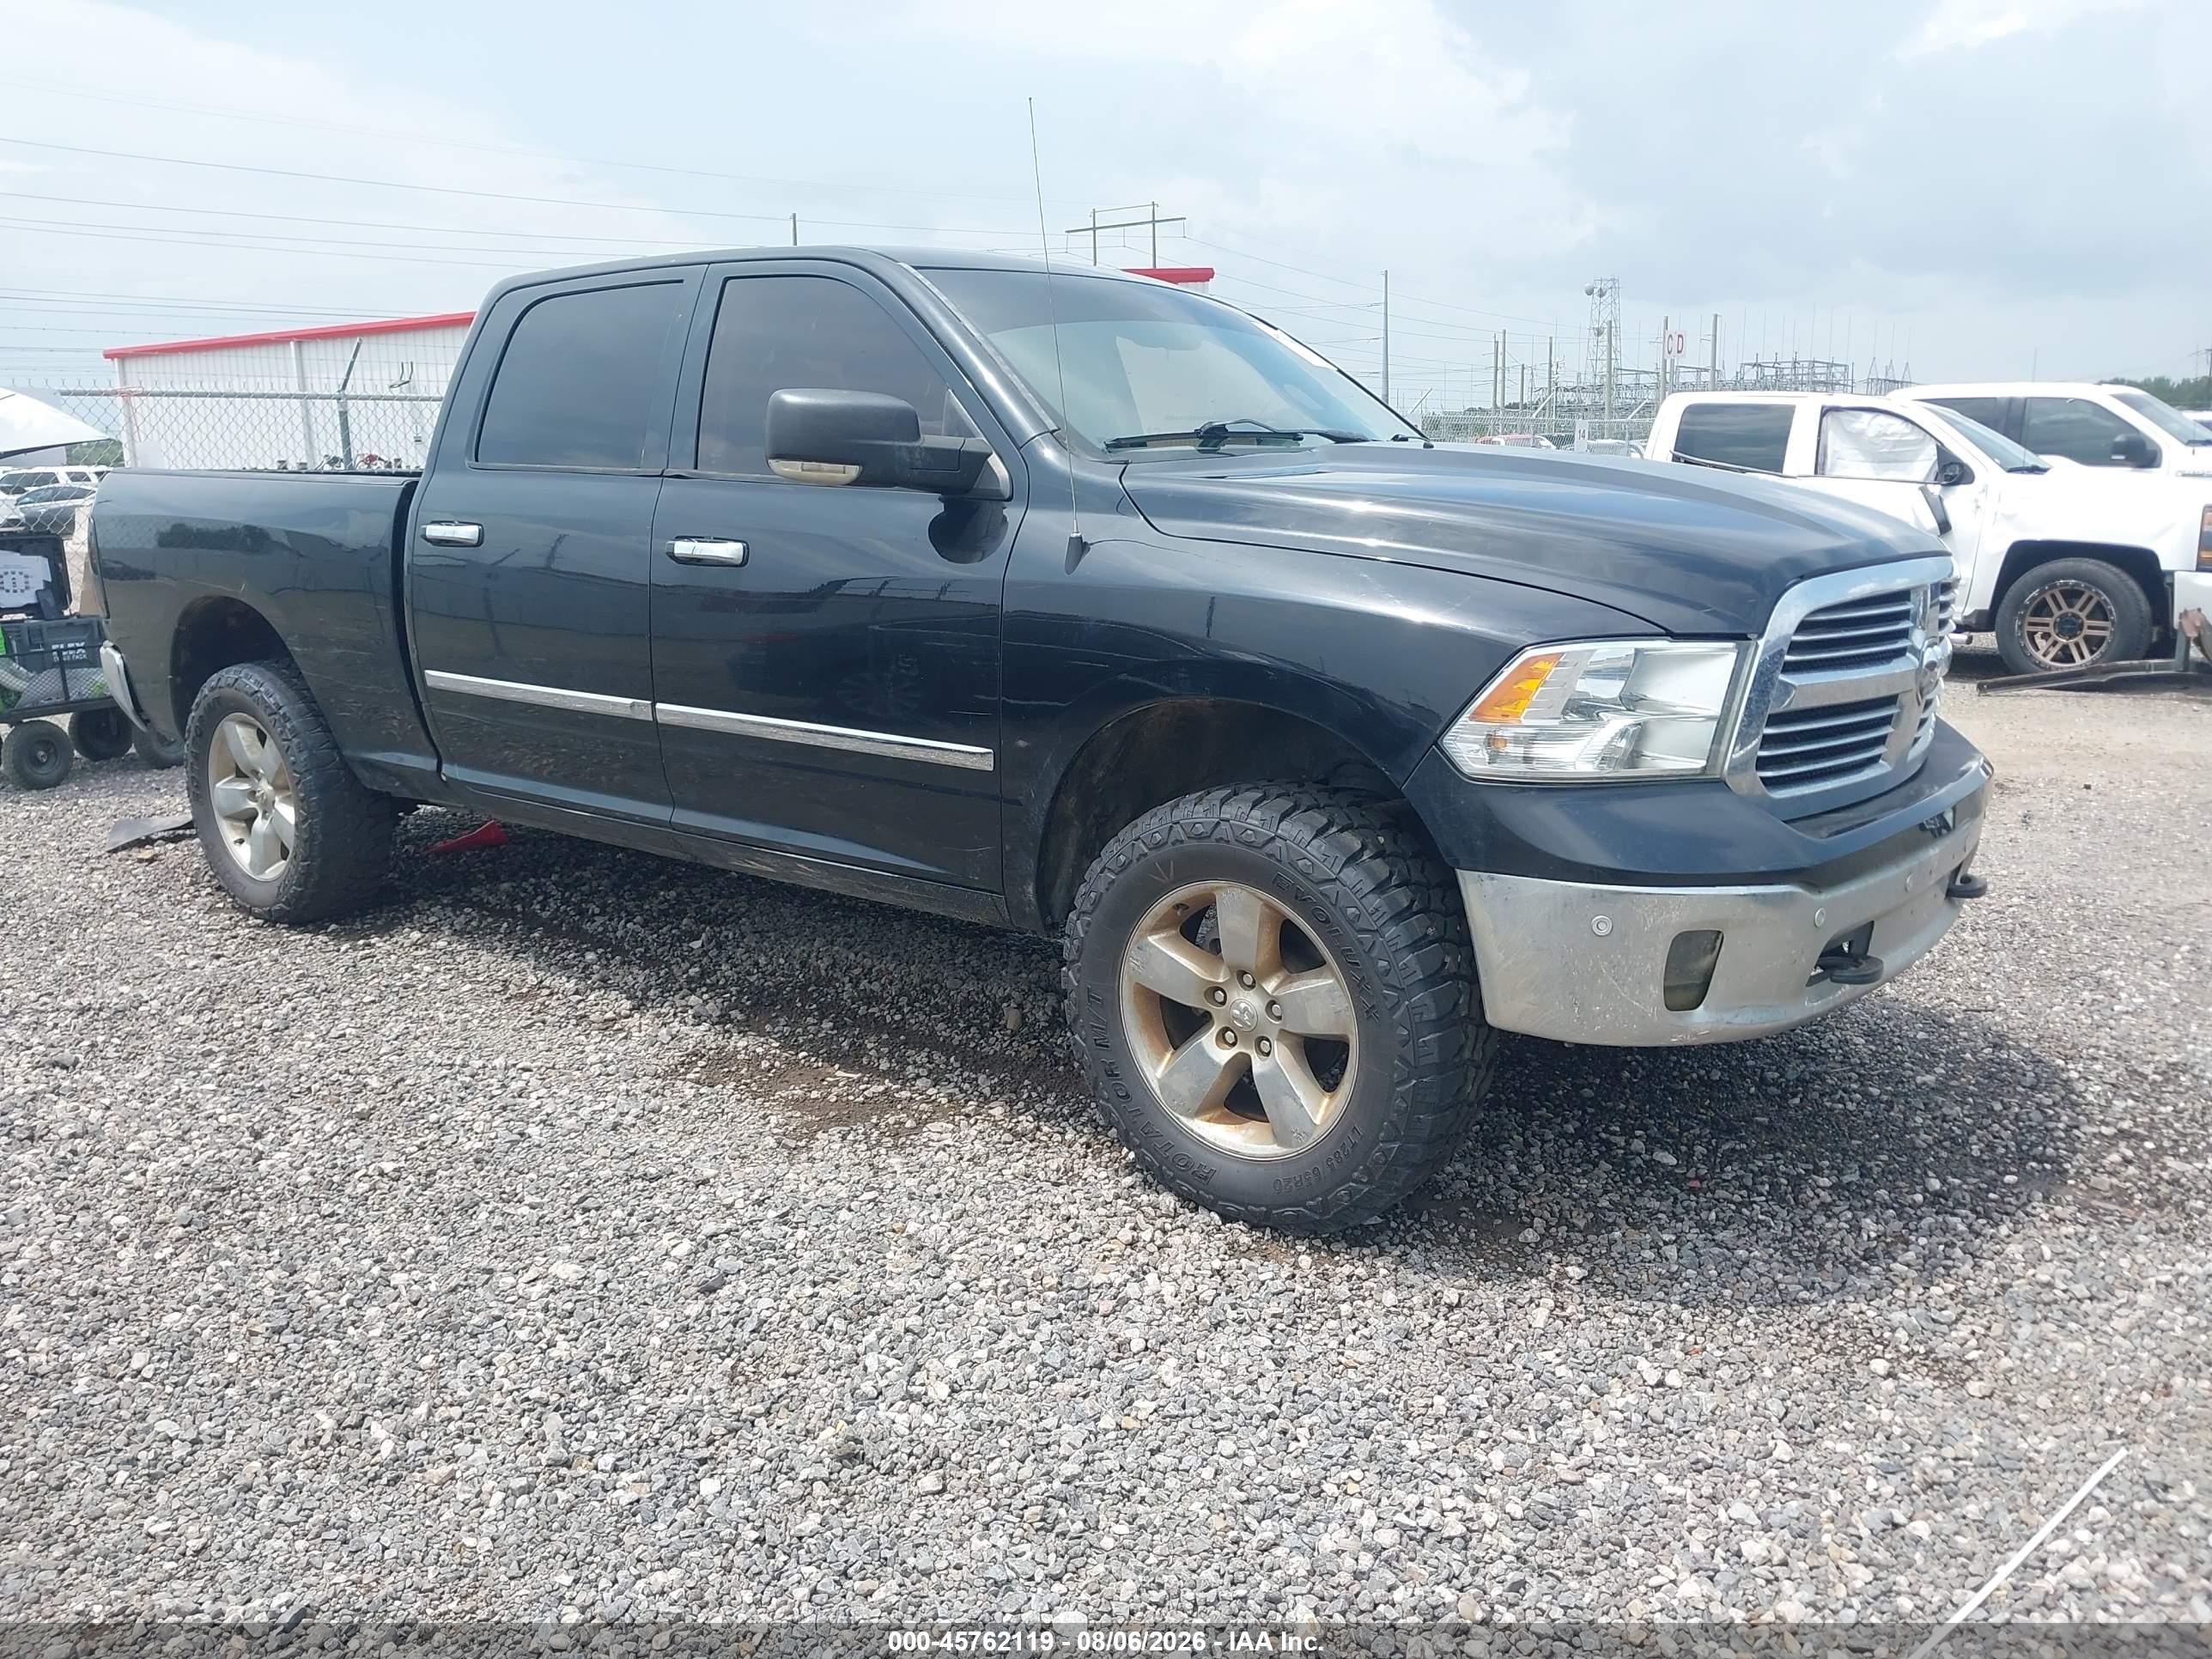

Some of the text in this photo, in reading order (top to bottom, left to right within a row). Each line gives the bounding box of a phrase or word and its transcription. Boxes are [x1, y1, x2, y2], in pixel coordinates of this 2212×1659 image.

[1577, 428, 1586, 441] 14
[1272, 872, 1381, 1024] EVOLUXX
[1086, 985, 1218, 1185] ROTATOR M/T
